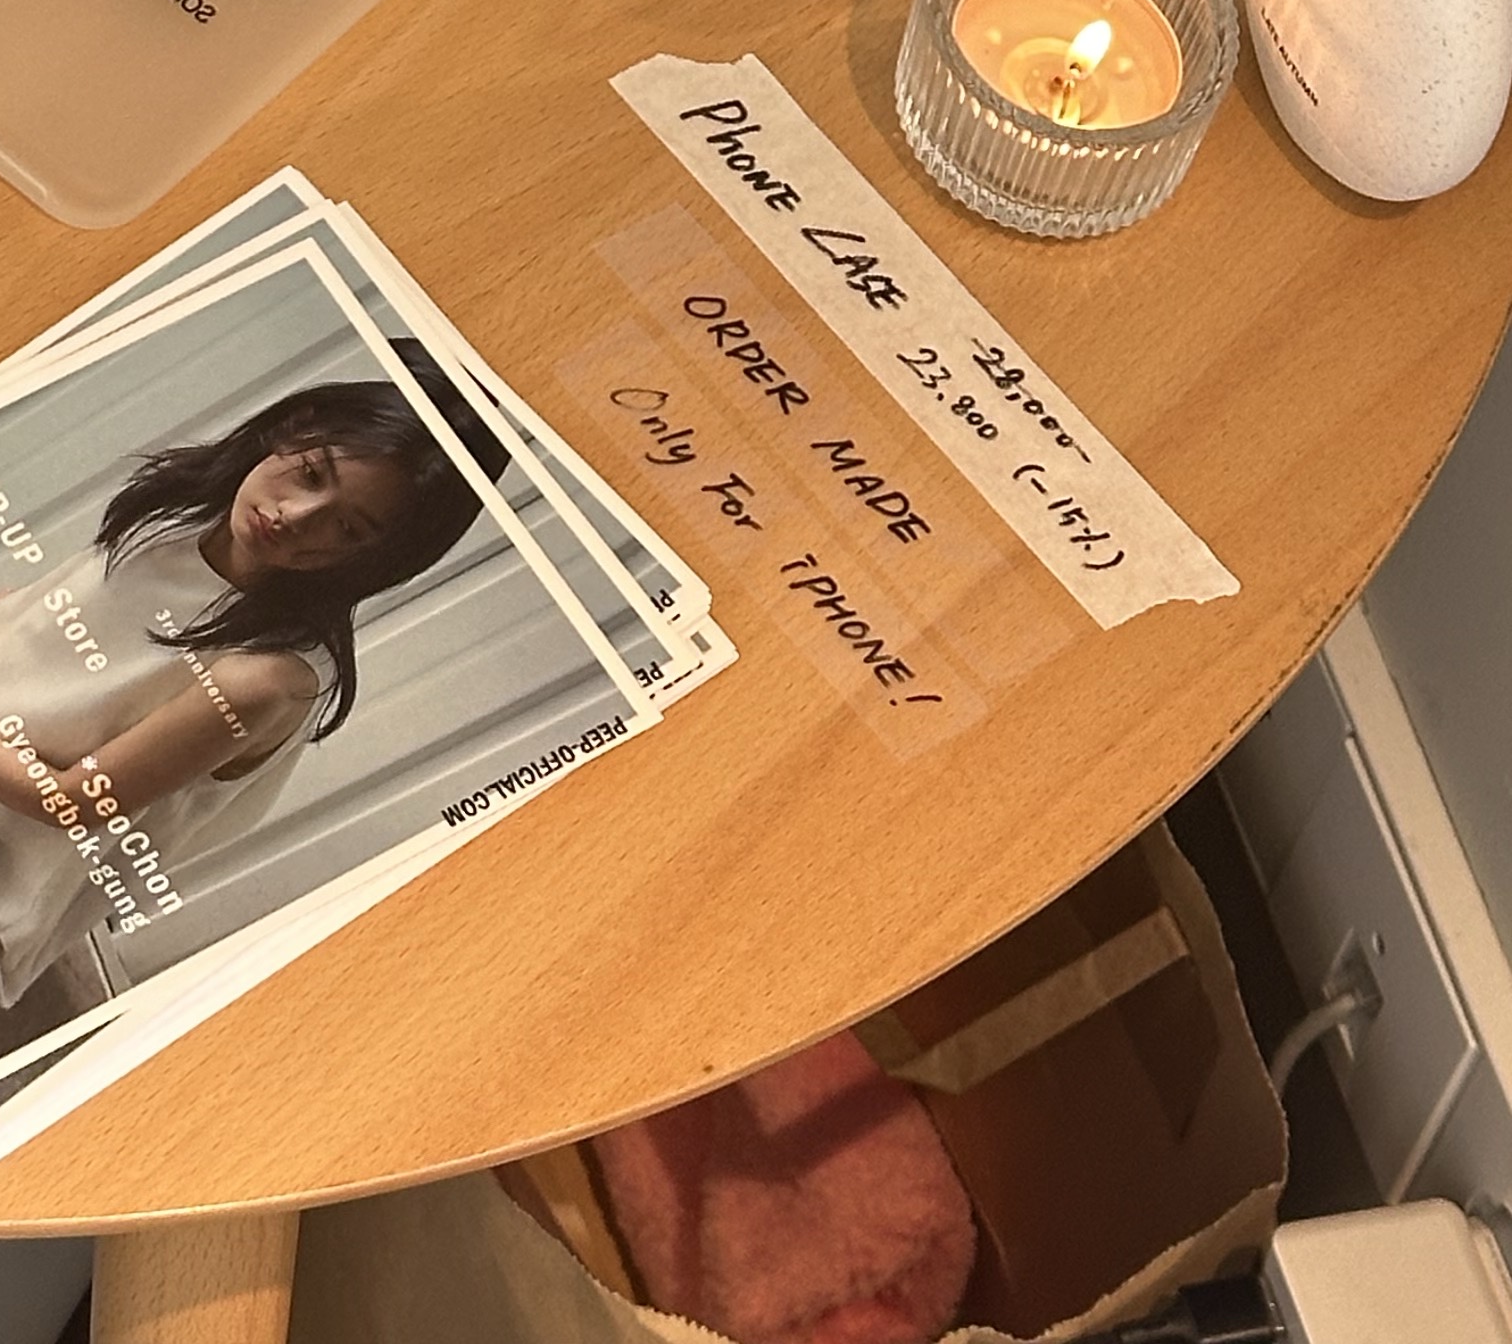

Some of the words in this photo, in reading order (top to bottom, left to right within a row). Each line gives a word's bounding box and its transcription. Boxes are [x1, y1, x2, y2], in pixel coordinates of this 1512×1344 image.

[608, 385, 698, 467] Only
[700, 471, 765, 535] For
[683, 295, 811, 417] ORDER
[810, 438, 933, 546] MADE
[42, 586, 110, 675] Store
[440, 713, 630, 829] PEEP-OFFICIAL.COM
